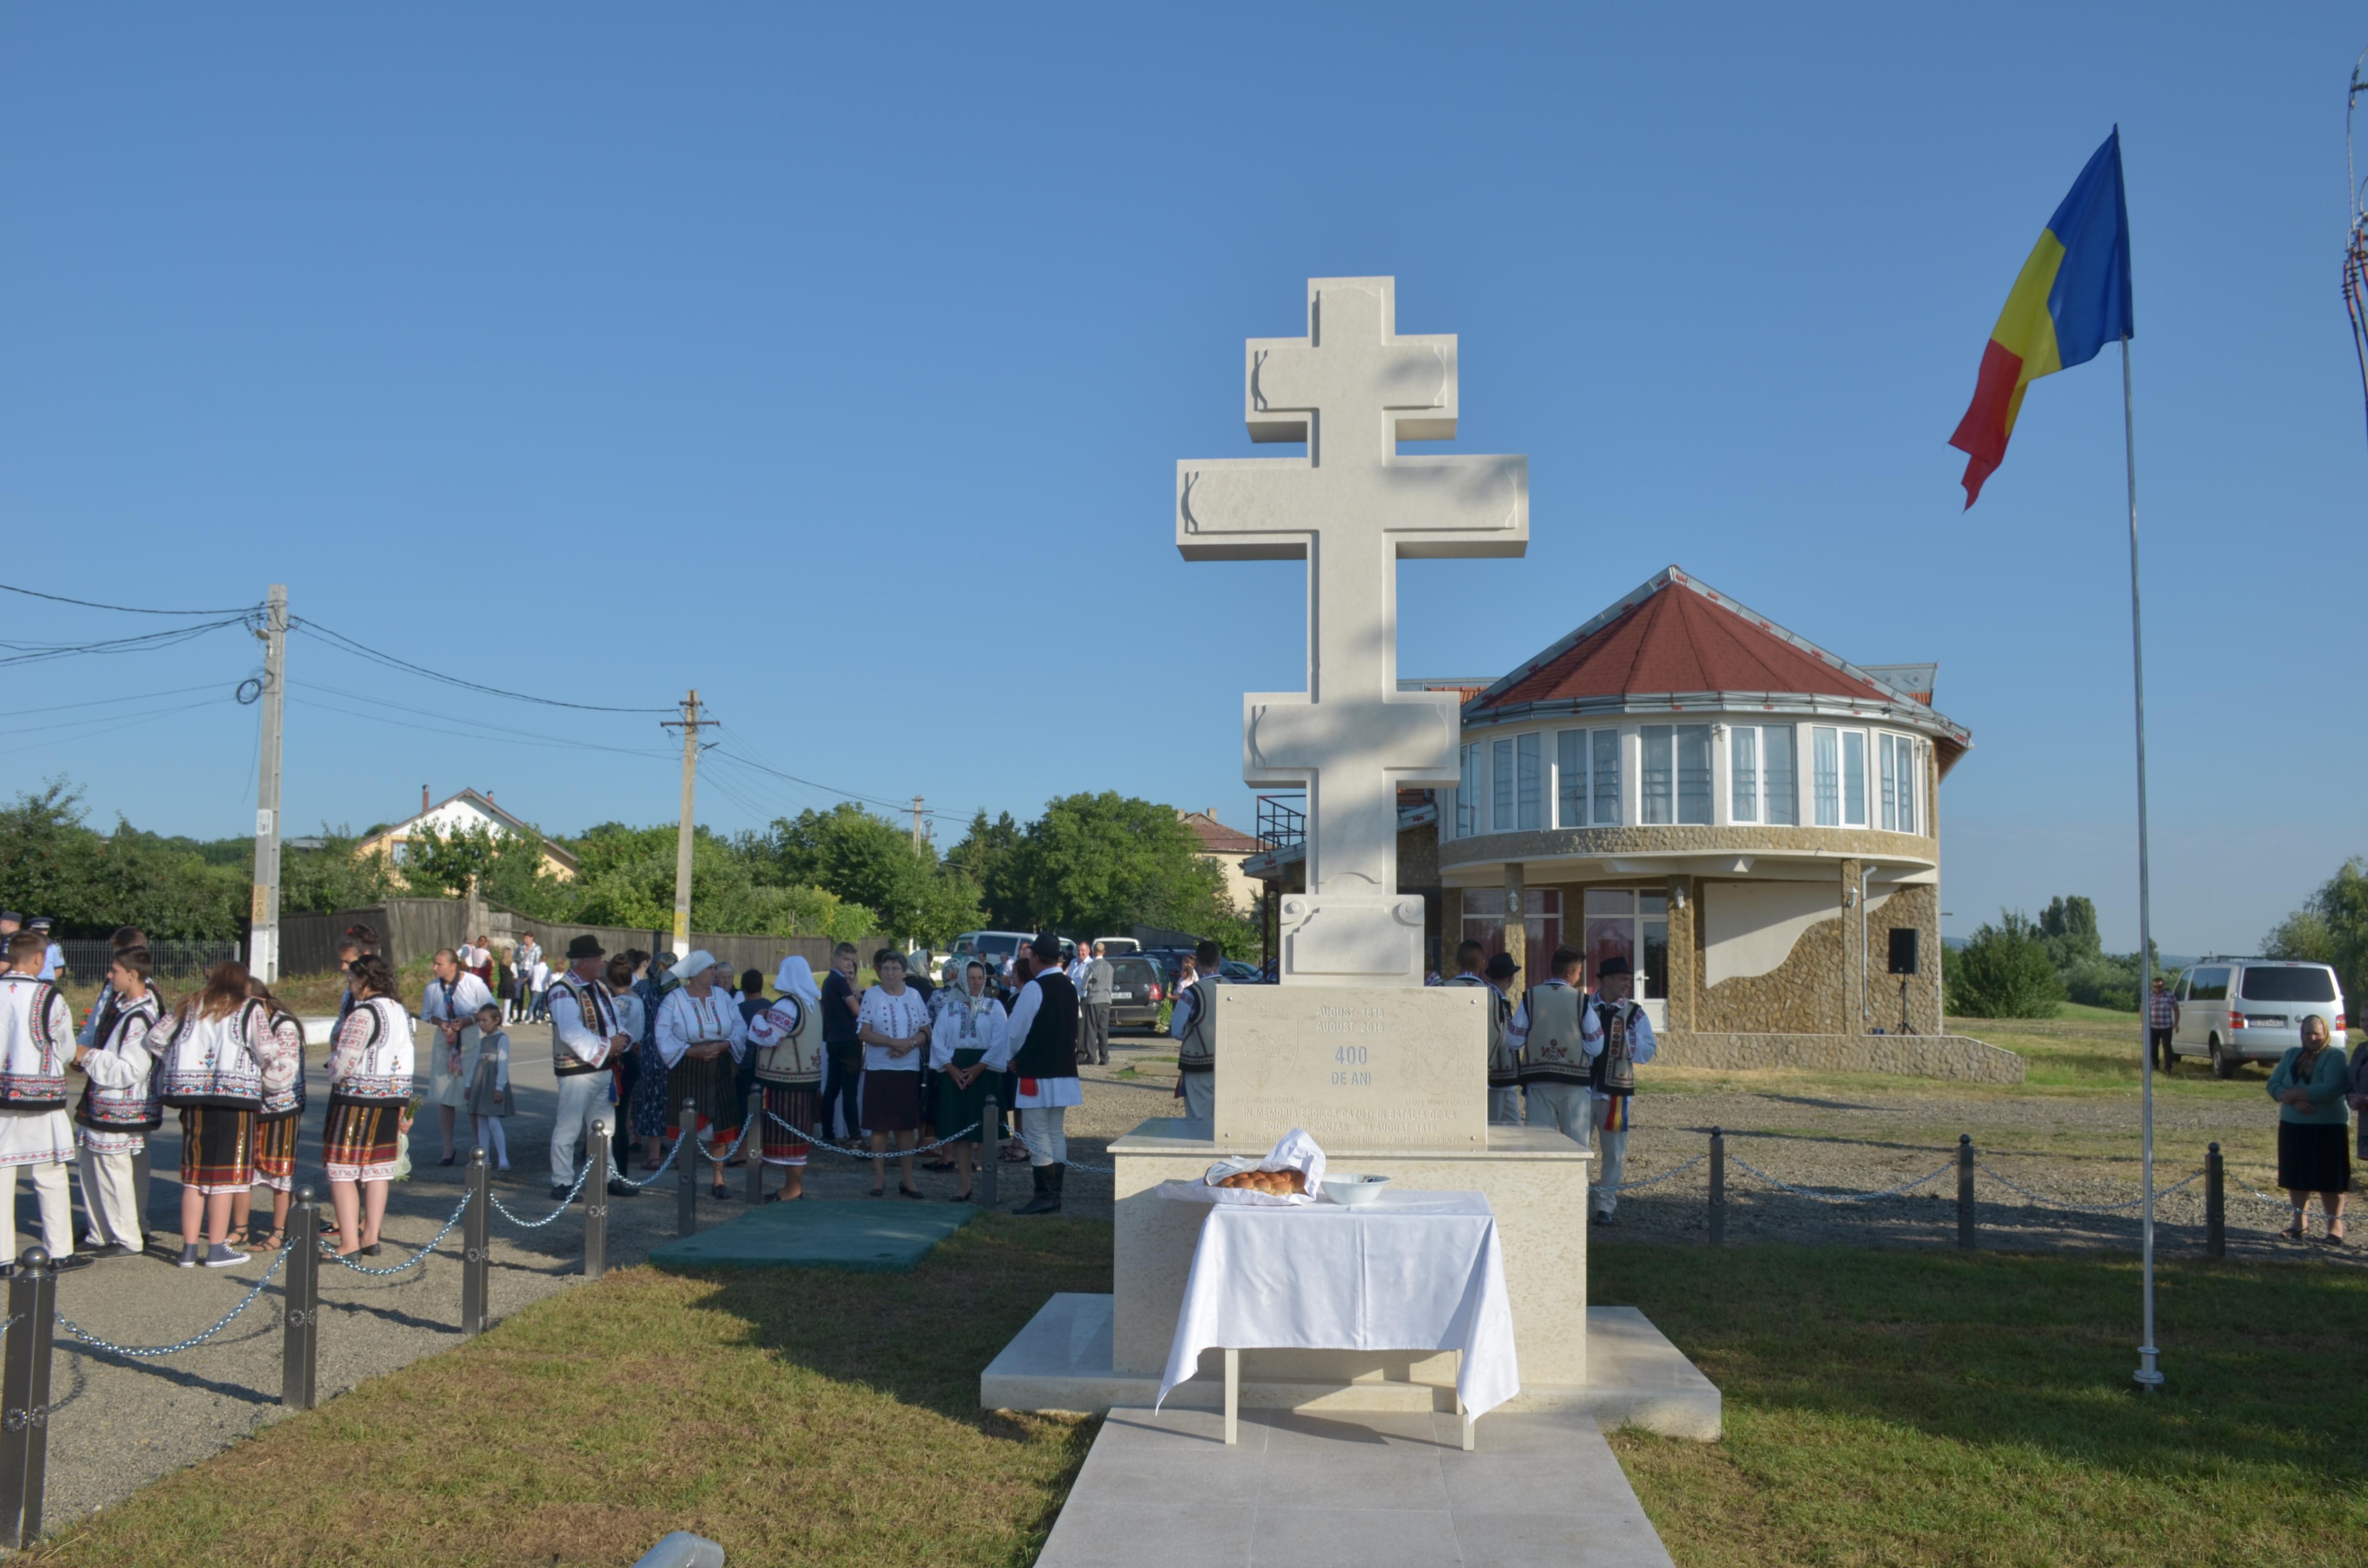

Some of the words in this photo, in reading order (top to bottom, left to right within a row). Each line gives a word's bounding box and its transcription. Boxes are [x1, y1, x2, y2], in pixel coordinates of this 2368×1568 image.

[1317, 1007, 1355, 1017] AUGUST
[1362, 1007, 1384, 1017] 1616
[1317, 1022, 1355, 1032] AUGUST
[1361, 1022, 1384, 1032] 2016
[1334, 1045, 1367, 1065] 400
[1331, 1072, 1346, 1085] DE
[1351, 1072, 1371, 1085] ANI
[1255, 1108, 1297, 1118] MEMORIA
[1301, 1108, 1338, 1118] EROILOR
[1430, 1110, 1441, 1119] DE
[1444, 1111, 1456, 1120] LA
[1264, 1121, 1291, 1130] PODUL
[1362, 1123, 1372, 1132] 21
[1375, 1123, 1410, 1133] AUGUST
[1416, 1124, 1436, 1133] 1616
[1242, 1134, 1269, 1142] RIDICAT
[1271, 1134, 1281, 1142] DE
[1322, 1135, 1344, 1143] LOCAL
